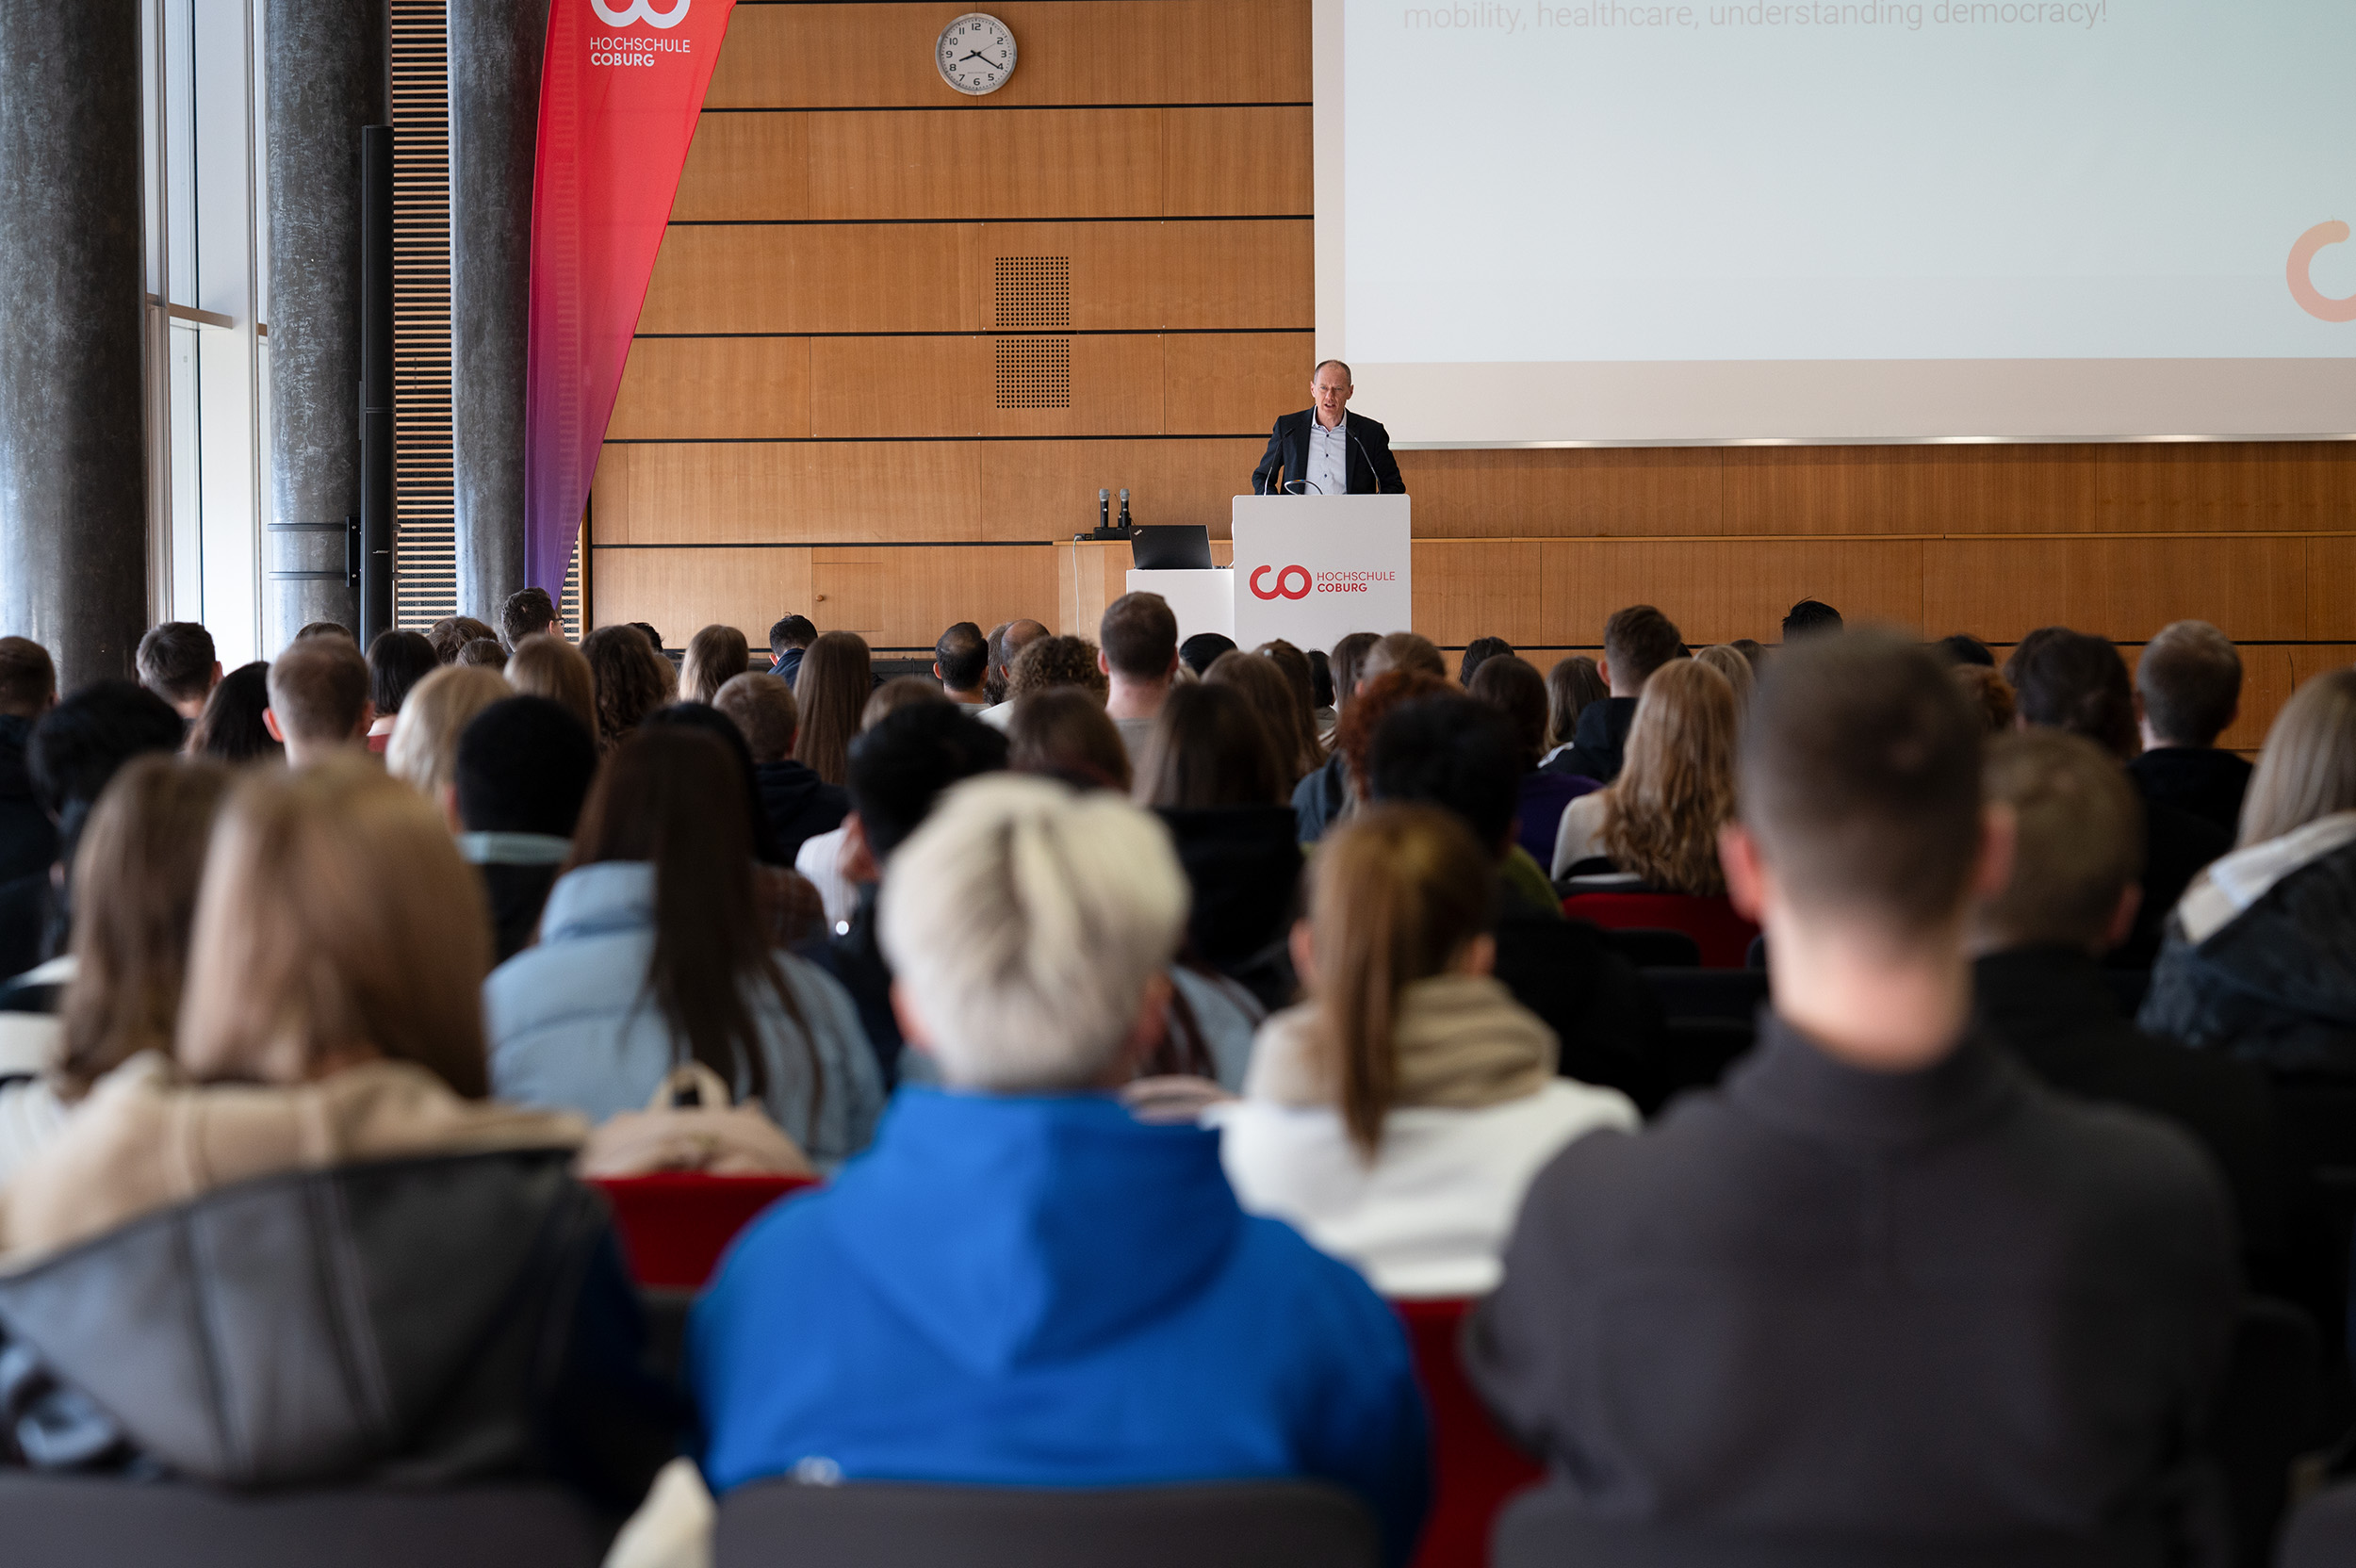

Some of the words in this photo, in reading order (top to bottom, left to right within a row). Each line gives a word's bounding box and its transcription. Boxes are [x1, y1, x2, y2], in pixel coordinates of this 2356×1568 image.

[1404, 0, 1527, 35] mobility,
[1537, 0, 1698, 30] healthcare,
[1710, 0, 1923, 31] understanding
[1933, 0, 2107, 30] democracy!
[972, 23, 981, 31] 12
[590, 37, 691, 53] HOCHSCHULE
[996, 37, 1004, 45] 2
[945, 50, 953, 58] 9
[1000, 50, 1007, 58] 3
[590, 52, 655, 67] COBURG
[949, 63, 957, 72] 8
[997, 62, 1004, 71] 4
[958, 74, 965, 82] 7
[973, 77, 980, 86] 6
[1317, 571, 1396, 581] HOCHSCHULE
[1249, 564, 1313, 600] CO
[1317, 582, 1367, 593] COBURG
